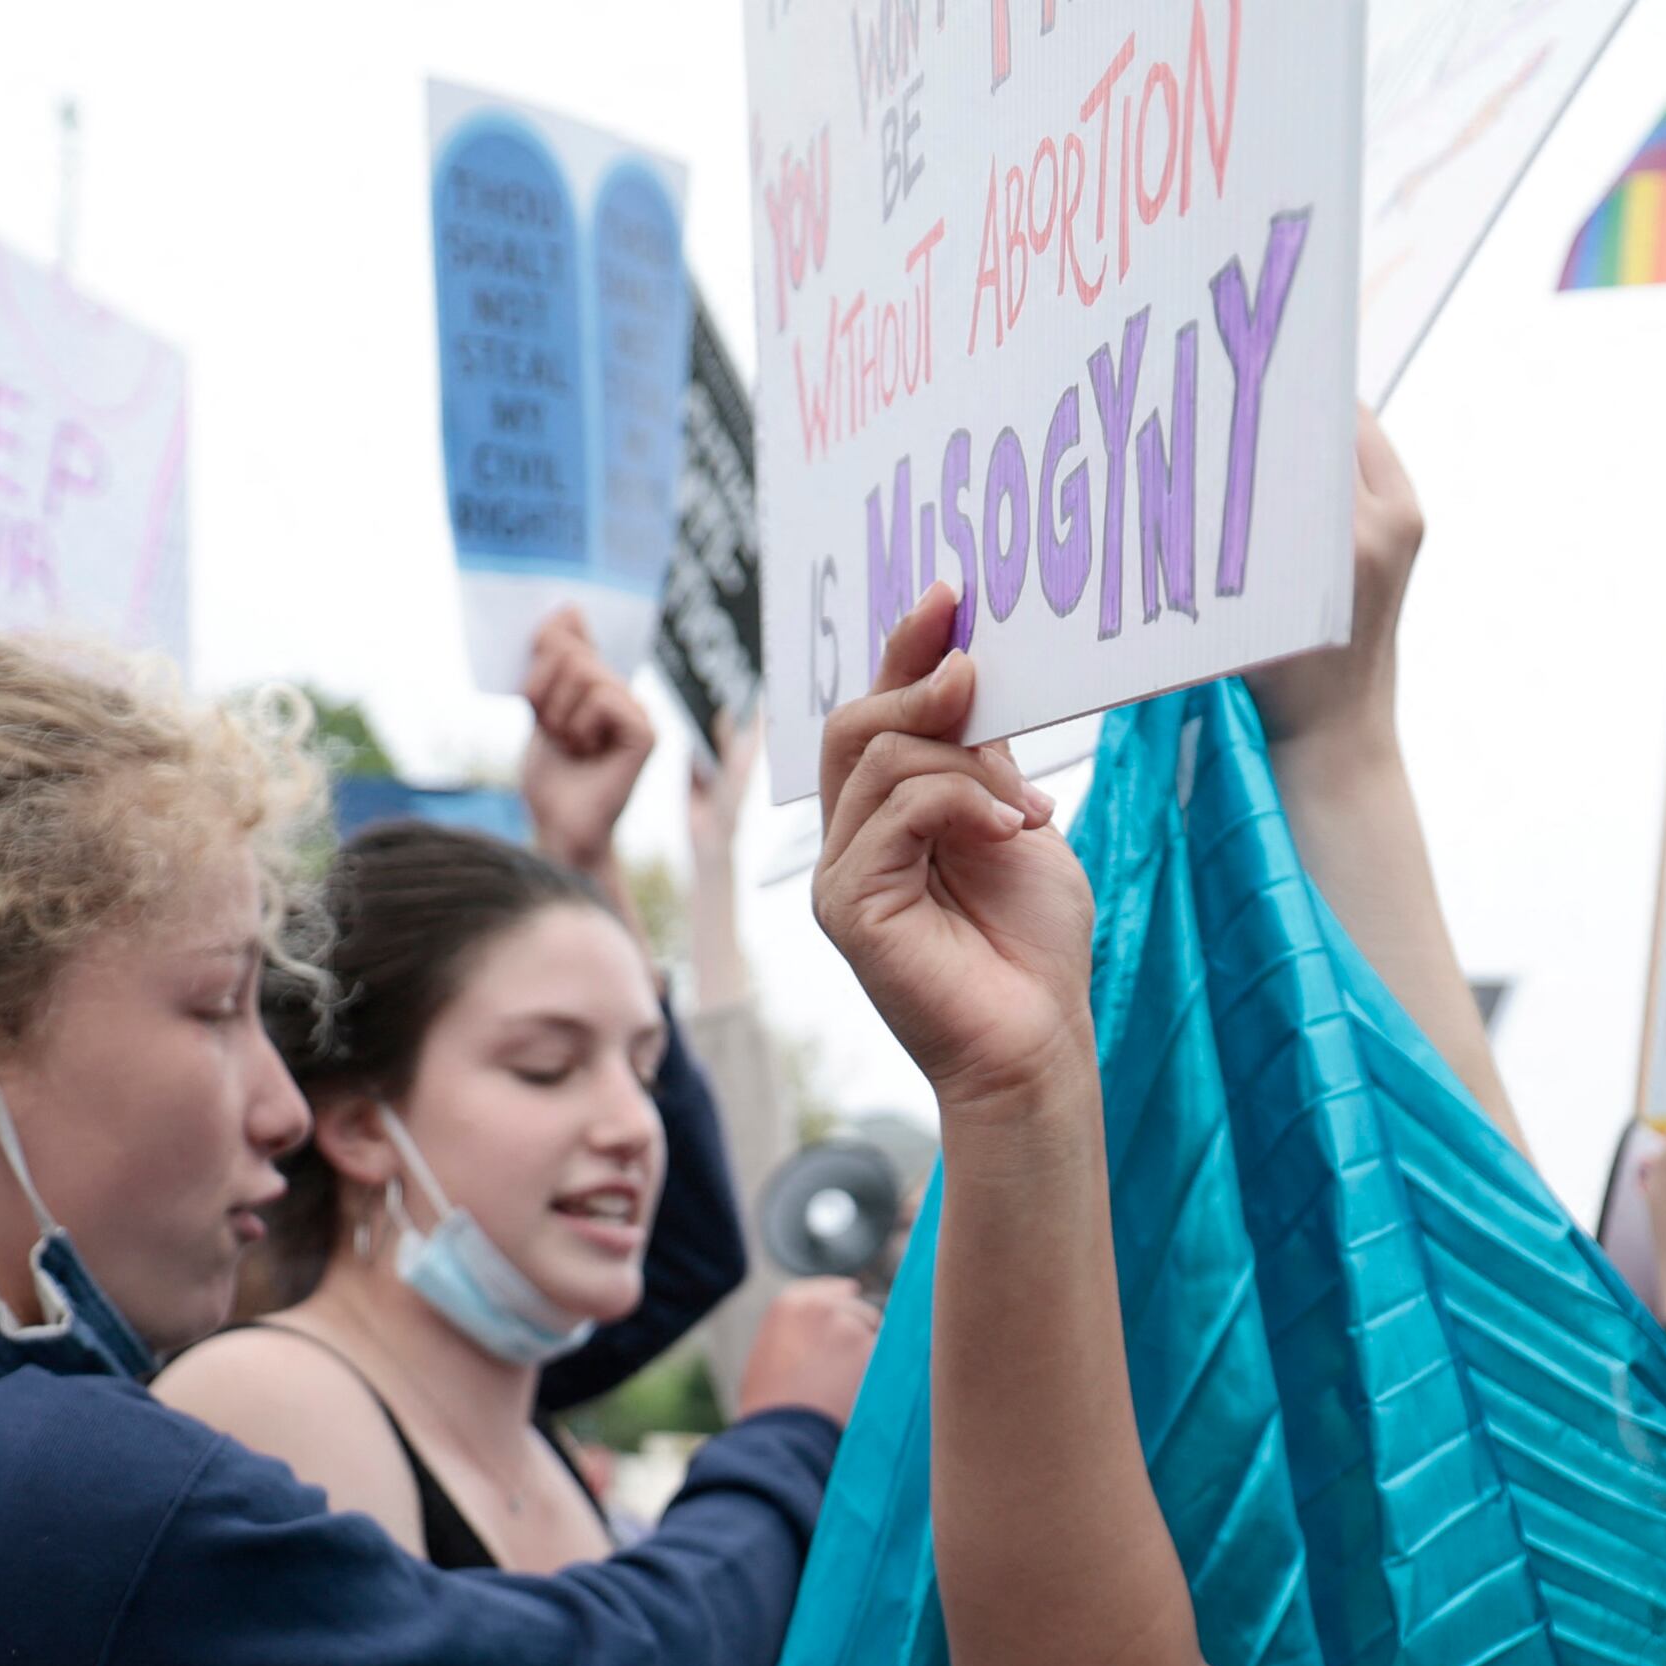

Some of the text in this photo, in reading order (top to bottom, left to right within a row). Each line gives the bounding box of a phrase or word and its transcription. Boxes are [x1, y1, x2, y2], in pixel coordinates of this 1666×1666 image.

[764, 117, 831, 335] YOU
[792, 217, 946, 466] WITHOUT
[967, 0, 1241, 356] ABORTION
[881, 69, 926, 225] BE
[809, 554, 839, 718] IS
[865, 204, 1313, 690] MISOGYNY
